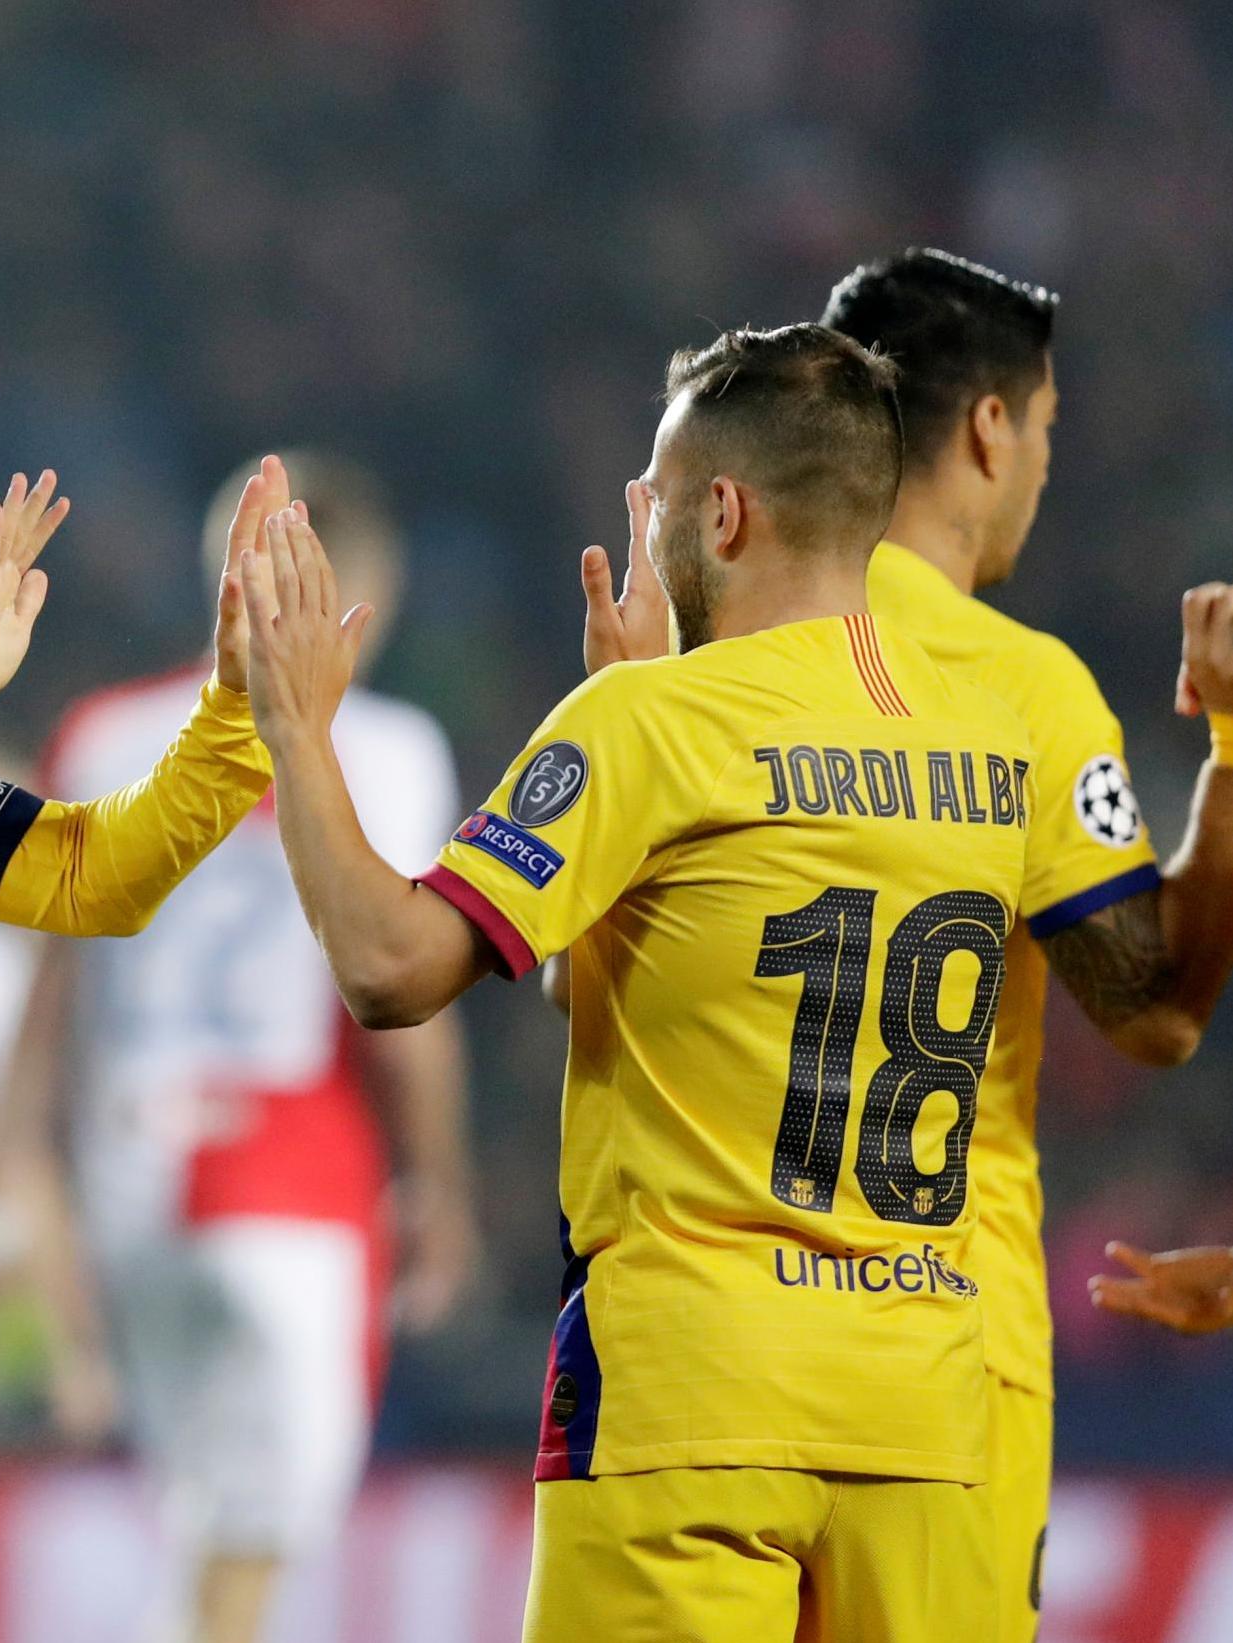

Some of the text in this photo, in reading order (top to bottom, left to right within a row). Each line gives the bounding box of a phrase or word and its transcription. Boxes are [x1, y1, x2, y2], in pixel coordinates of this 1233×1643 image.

[529, 780, 552, 803] 5
[753, 745, 917, 820] JORDI
[479, 824, 558, 878] RESPECT
[753, 885, 1007, 1227] 18
[775, 1244, 935, 1294] unicef
